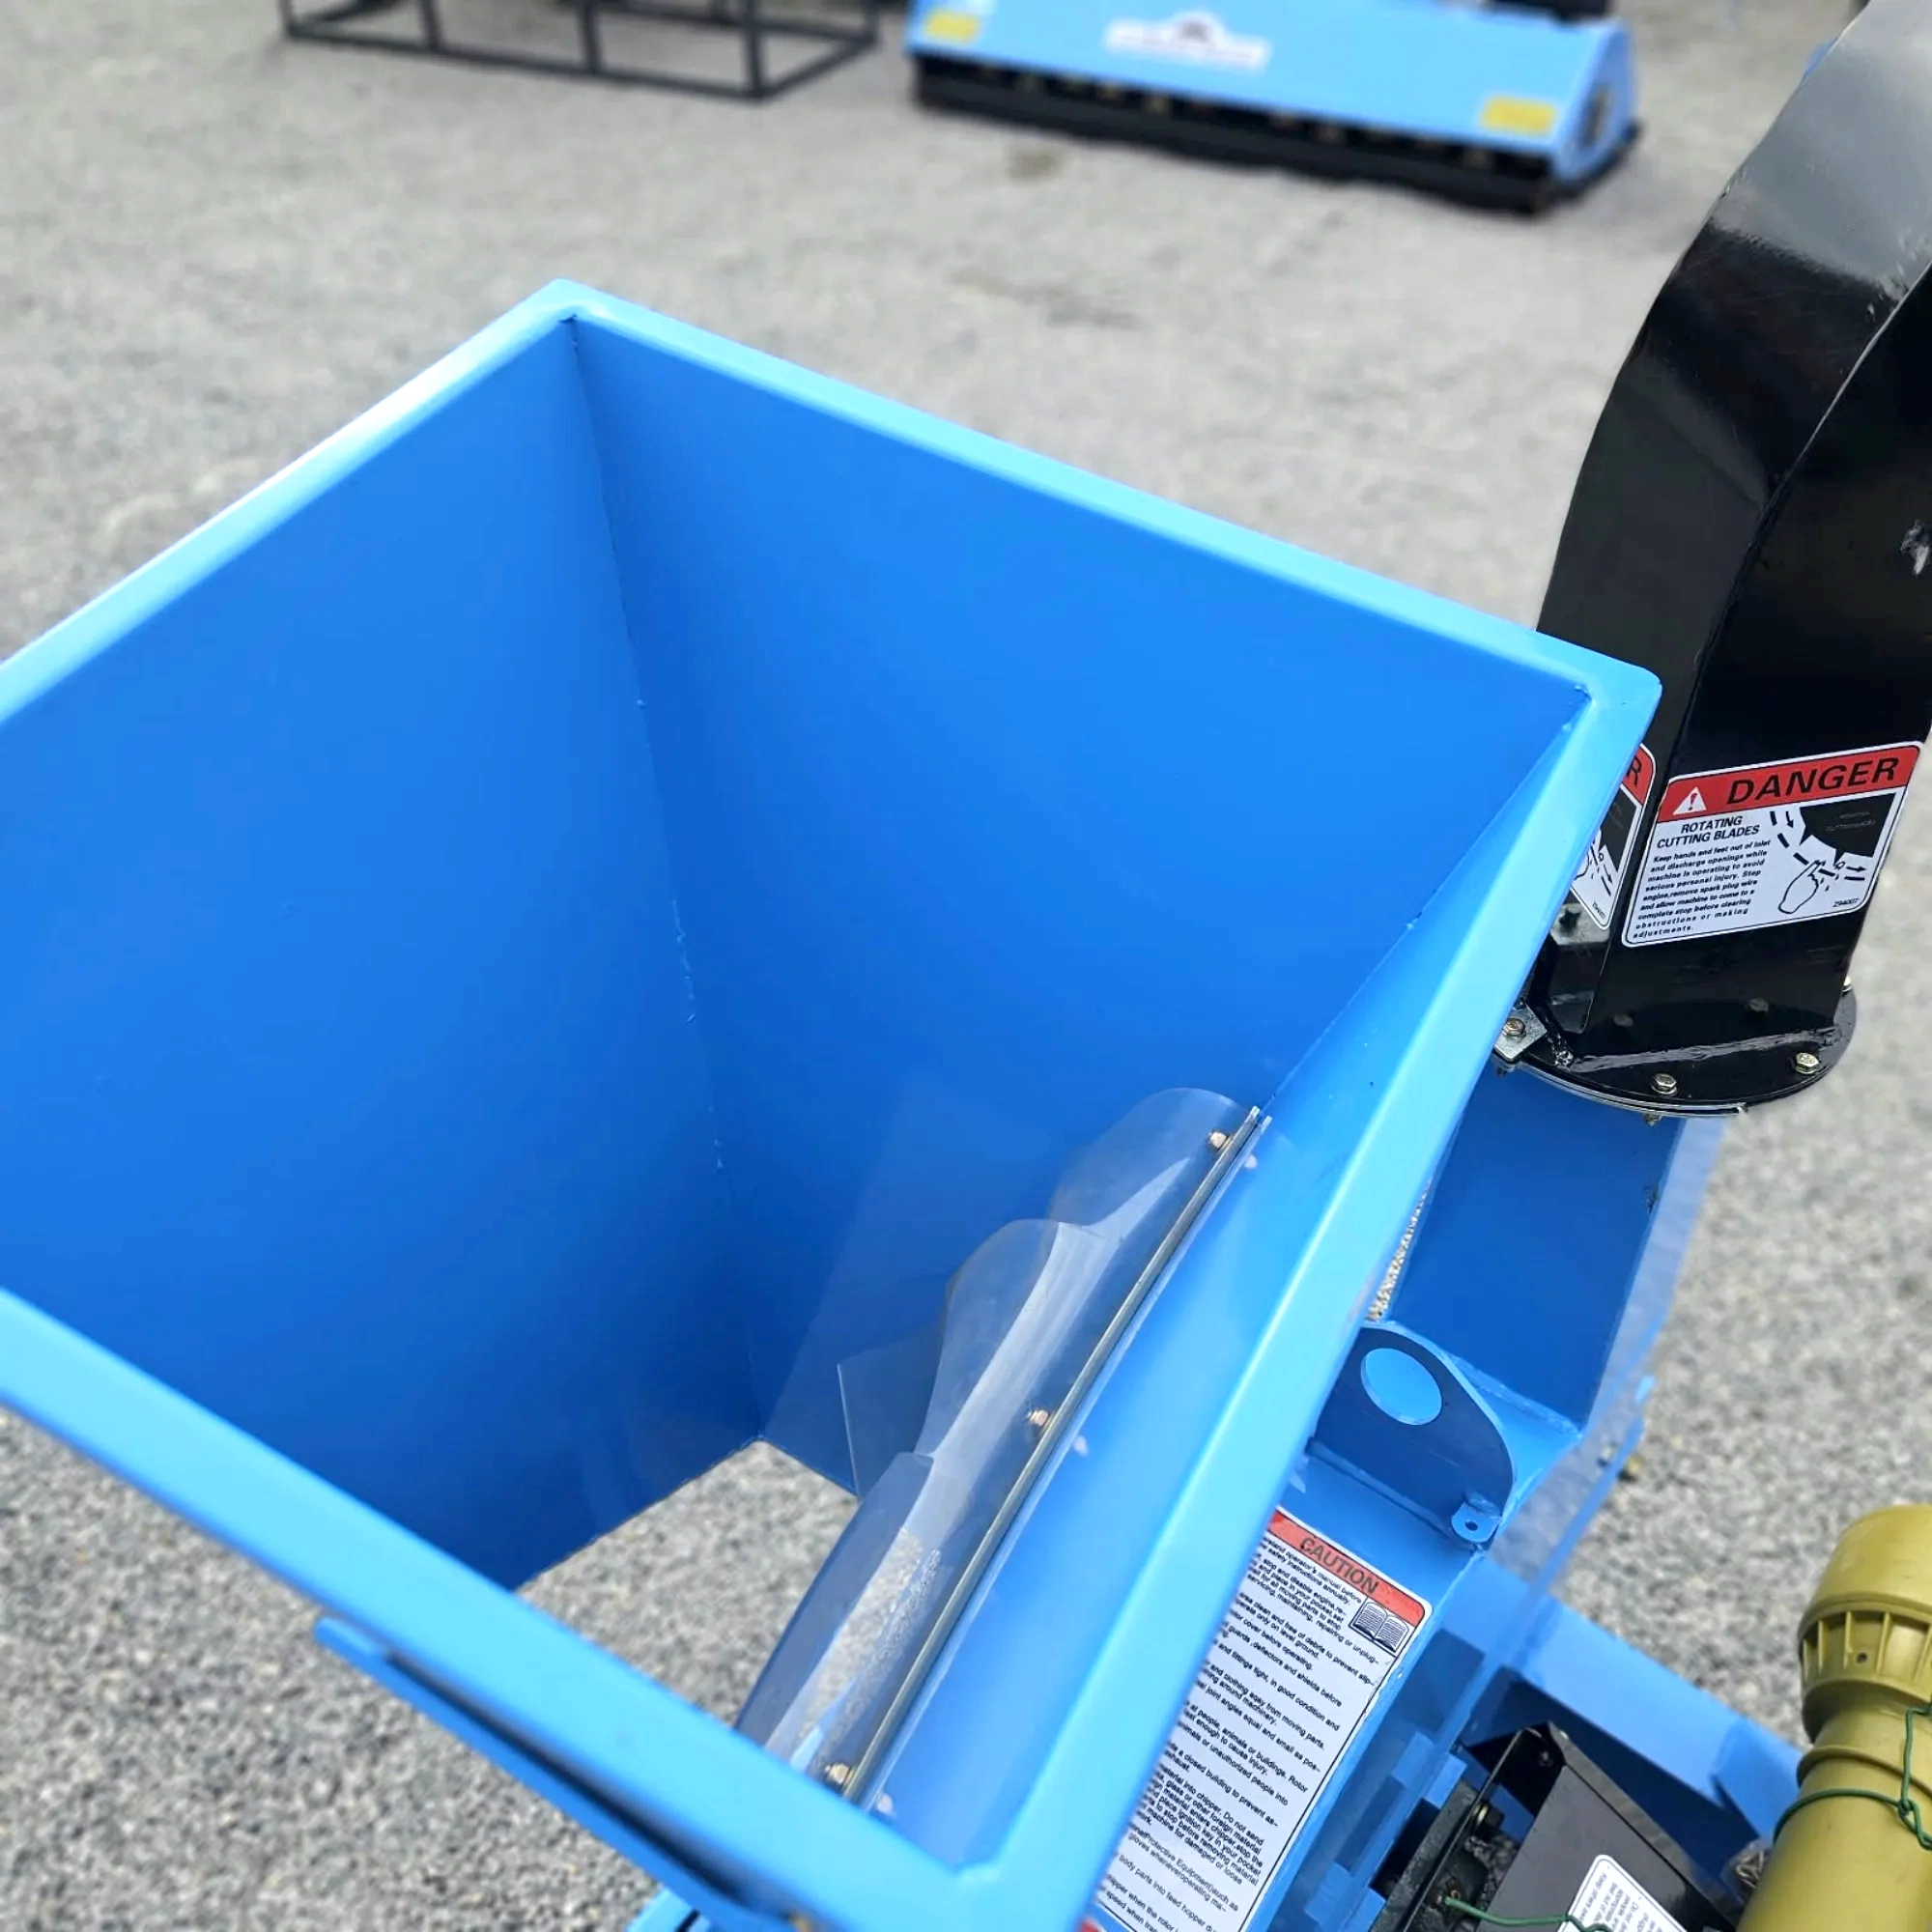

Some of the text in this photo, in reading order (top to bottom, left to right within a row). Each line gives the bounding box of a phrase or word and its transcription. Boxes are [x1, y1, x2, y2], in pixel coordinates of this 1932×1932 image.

[1725, 756, 1900, 805] DANGER
[1656, 824, 1760, 849] CUTTING BLADES
[1680, 815, 1743, 834] ROTATING
[1647, 871, 1681, 882] machine
[1691, 864, 1730, 876] operating
[1742, 858, 1765, 867] avoid
[1650, 849, 1768, 872] and discharge openings while
[1653, 854, 1672, 863] Keep
[1673, 850, 1696, 859] hands
[1697, 847, 1713, 856] and
[1753, 838, 1771, 847] inlet
[1645, 868, 1761, 892] serious personal injury. Stop
[1676, 895, 1708, 904] machine
[1699, 884, 1720, 894] spark
[1721, 881, 1740, 891] plug
[1635, 915, 1696, 929] obstructions
[1714, 907, 1748, 918] making
[1636, 897, 1751, 921] complete stop before clearing
[1258, 1563, 1271, 1575] and
[1269, 1572, 1289, 1587] place
[1262, 1557, 1277, 1571] stop
[1276, 1567, 1290, 1578] and
[1290, 1576, 1313, 1594] disable
[1267, 1548, 1350, 1605] safety instructions annually.
[1285, 1549, 1362, 1604] operator's manual before
[1298, 1536, 1379, 1595] CAUTION
[1278, 1585, 1342, 1631] moving parts to stop
[1315, 1619, 1345, 1642] repairing
[1242, 1619, 1261, 1634] cover
[1261, 1630, 1282, 1648] before
[1281, 1645, 1314, 1671] operating.
[1253, 1601, 1358, 1676] clean and debris to prevent
[1255, 1612, 1270, 1626] only
[1279, 1628, 1295, 1642] level
[1294, 1639, 1320, 1660] ground.
[1217, 1642, 1340, 1731] and fittings good condition and
[1227, 1625, 1250, 1643] guards
[1283, 1662, 1297, 1675] and
[1296, 1672, 1321, 1691] shields
[1320, 1688, 1343, 1707] before
[1205, 1686, 1294, 1753] joint angles equal and small
[1209, 1663, 1224, 1676] and
[1222, 1672, 1249, 1695] clothing
[1265, 1702, 1282, 1718] from
[1281, 1714, 1307, 1737] moving
[1305, 1732, 1325, 1749] parts.
[1218, 1680, 1243, 1700] around
[1241, 1696, 1277, 1725] machinery.
[1195, 1718, 1268, 1776] enough cause injury.
[1209, 1744, 1252, 1778] unauthorized
[1250, 1775, 1275, 1796] people
[1221, 1726, 1248, 1748] animals
[1288, 1775, 1308, 1793] Rotor
[1183, 1753, 1265, 1818] closed building to prevent
[1157, 1795, 1178, 1813] place
[1177, 1808, 1202, 1832] ignition
[1201, 1827, 1214, 1842] key
[1213, 1836, 1222, 1847] in
[1220, 1844, 1237, 1859] your
[1236, 1855, 1262, 1877] pocket
[1162, 1787, 1189, 1811] material
[1189, 1807, 1210, 1827] enters
[1251, 1855, 1264, 1867] the
[1165, 1779, 1184, 1797] glass
[1183, 1794, 1192, 1803] or
[1191, 1799, 1210, 1815] other
[1208, 1812, 1234, 1834] foreign
[1233, 1831, 1262, 1855] material
[1182, 1781, 1264, 1845] into chipper. Do not send
[1127, 1832, 1150, 1853] gloves
[1146, 1806, 1243, 1885] machine for damaged or loose
[1155, 1802, 1163, 1812] to
[1162, 1808, 1179, 1824] stop
[1178, 1820, 1200, 1840] before
[1199, 1836, 1231, 1864] removing
[1230, 1861, 1259, 1885] material
[1105, 1889, 1144, 1923] speed when
[1118, 1854, 1206, 1927] body parts feed hopper
[1127, 1891, 1175, 1931] when the rotor
